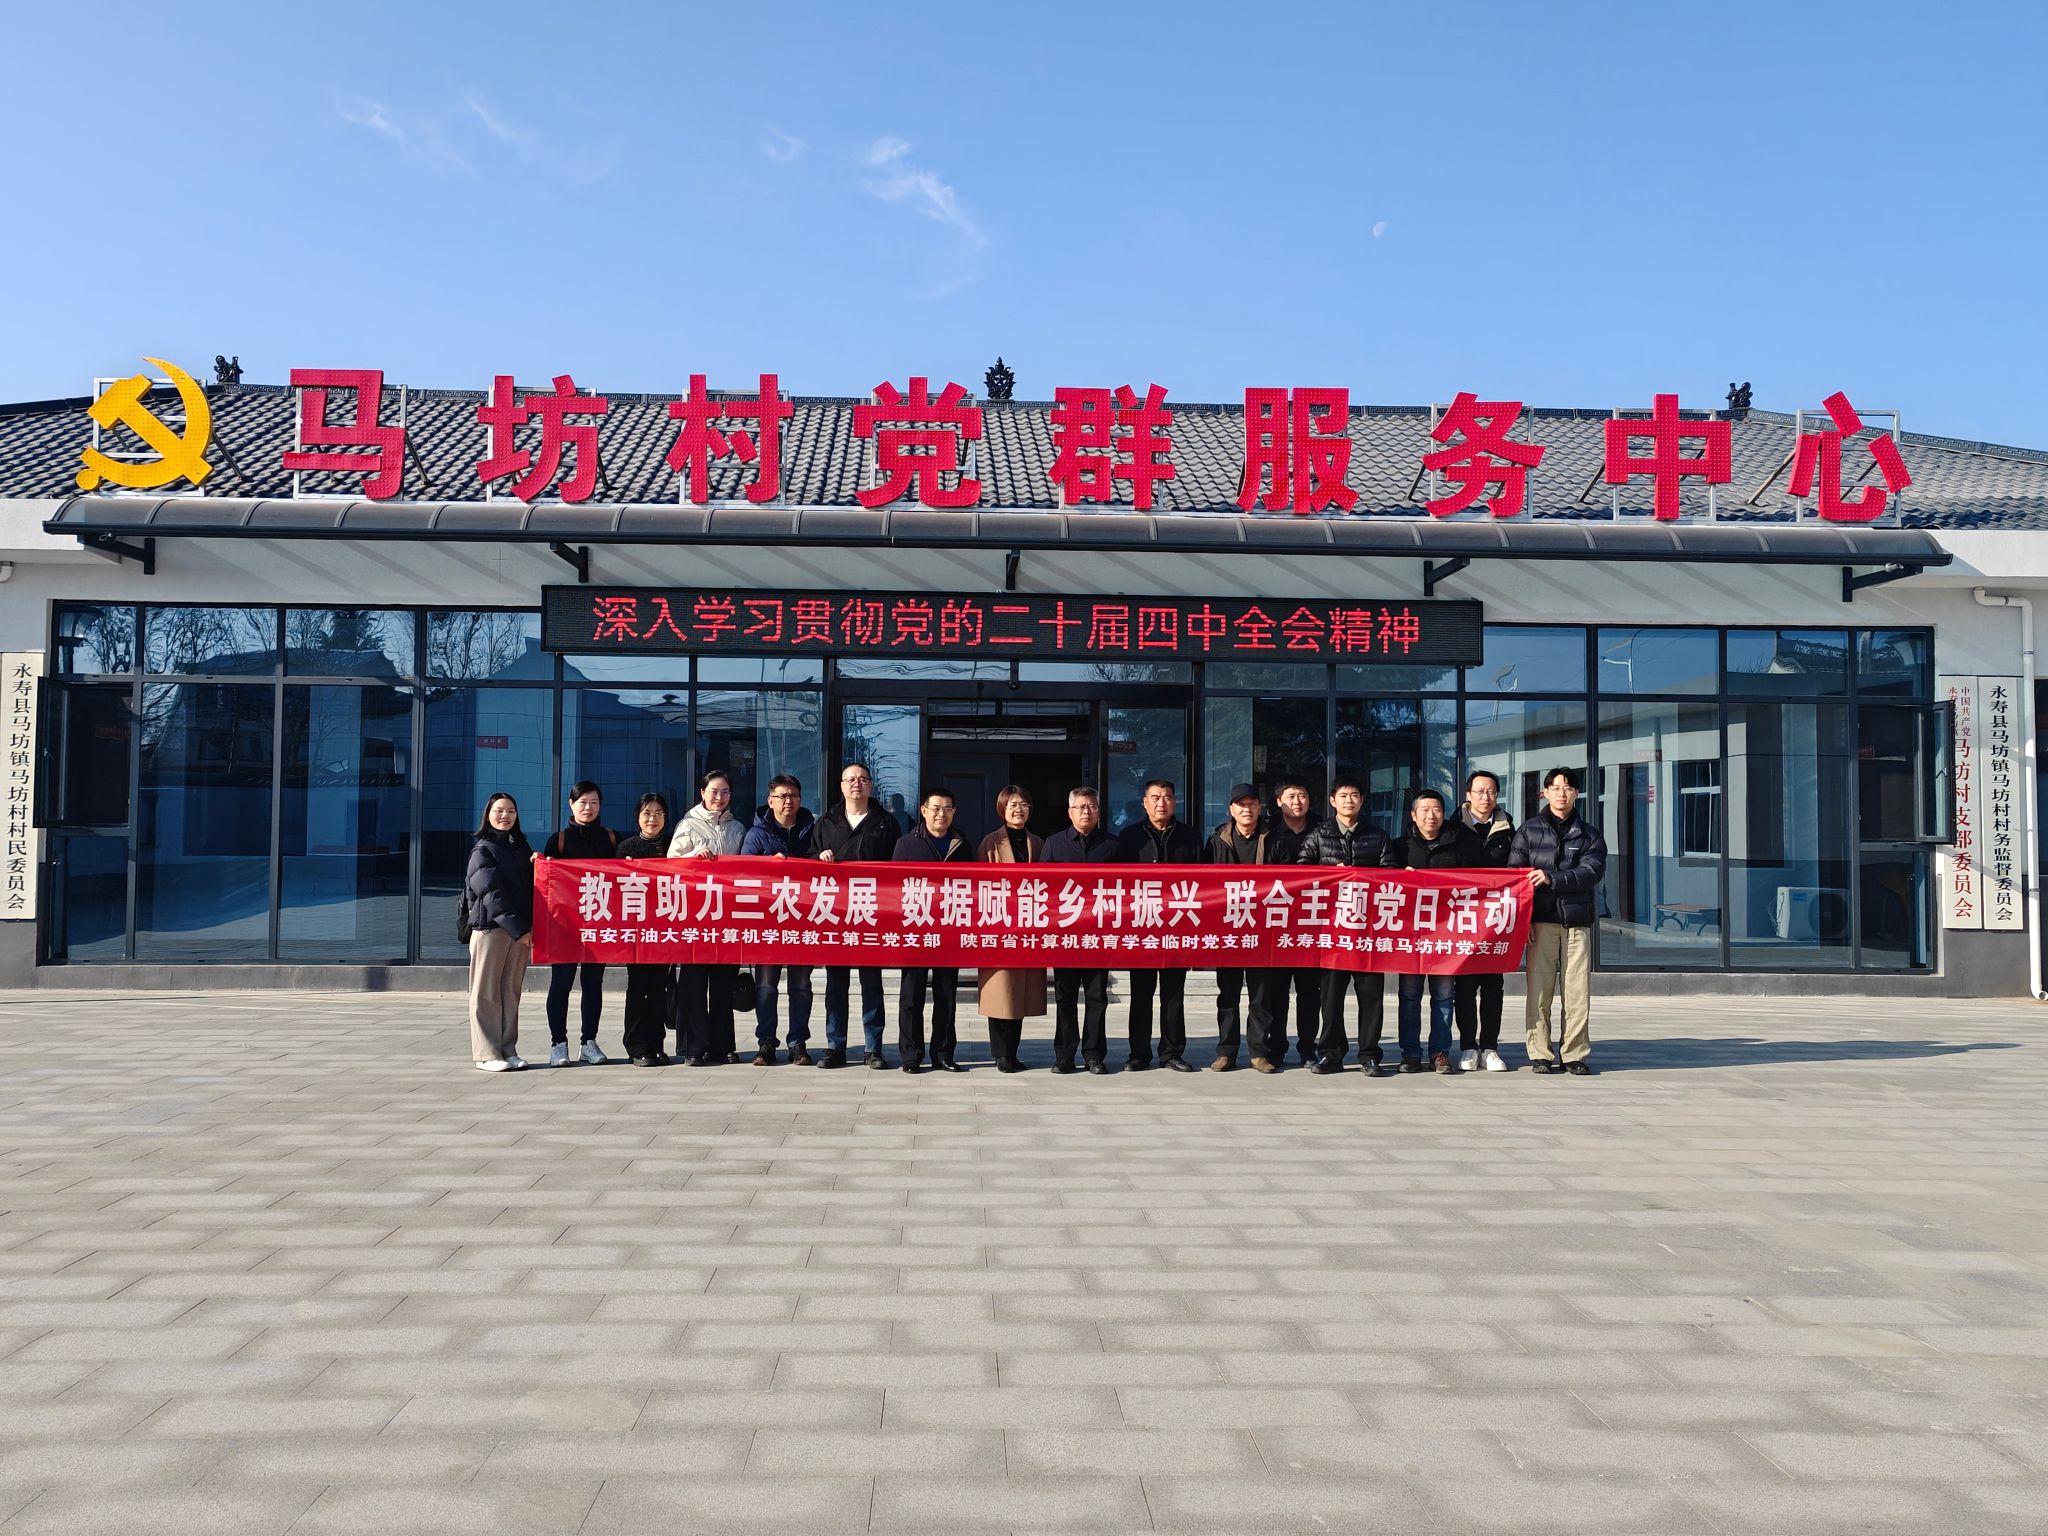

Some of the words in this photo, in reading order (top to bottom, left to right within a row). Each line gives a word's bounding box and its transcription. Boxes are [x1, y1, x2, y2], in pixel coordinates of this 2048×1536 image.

[283, 367, 1912, 522] 马坊村党群服务中心
[593, 596, 1420, 654] 深入学习贯彻党的二十届四中全会精神
[1960, 686, 1971, 737] 中国共产党
[7, 662, 33, 910] 永寿县马坊镇马坊村村民委员会
[1989, 685, 2014, 921] 永寿县马坊镇马坊村村务监督委员会
[578, 871, 879, 926] 教育助力三农发展
[901, 877, 1202, 929] 数据赋能乡村振兴
[1223, 880, 1517, 935] 联合主题党日活动
[580, 927, 942, 949] 西安石油大学计算机学院教工第三党支部
[960, 932, 1260, 950] 陕西省计算机教育学会临时党支部
[1276, 935, 1510, 956] 永寿县马坊镇马坊村党支部
